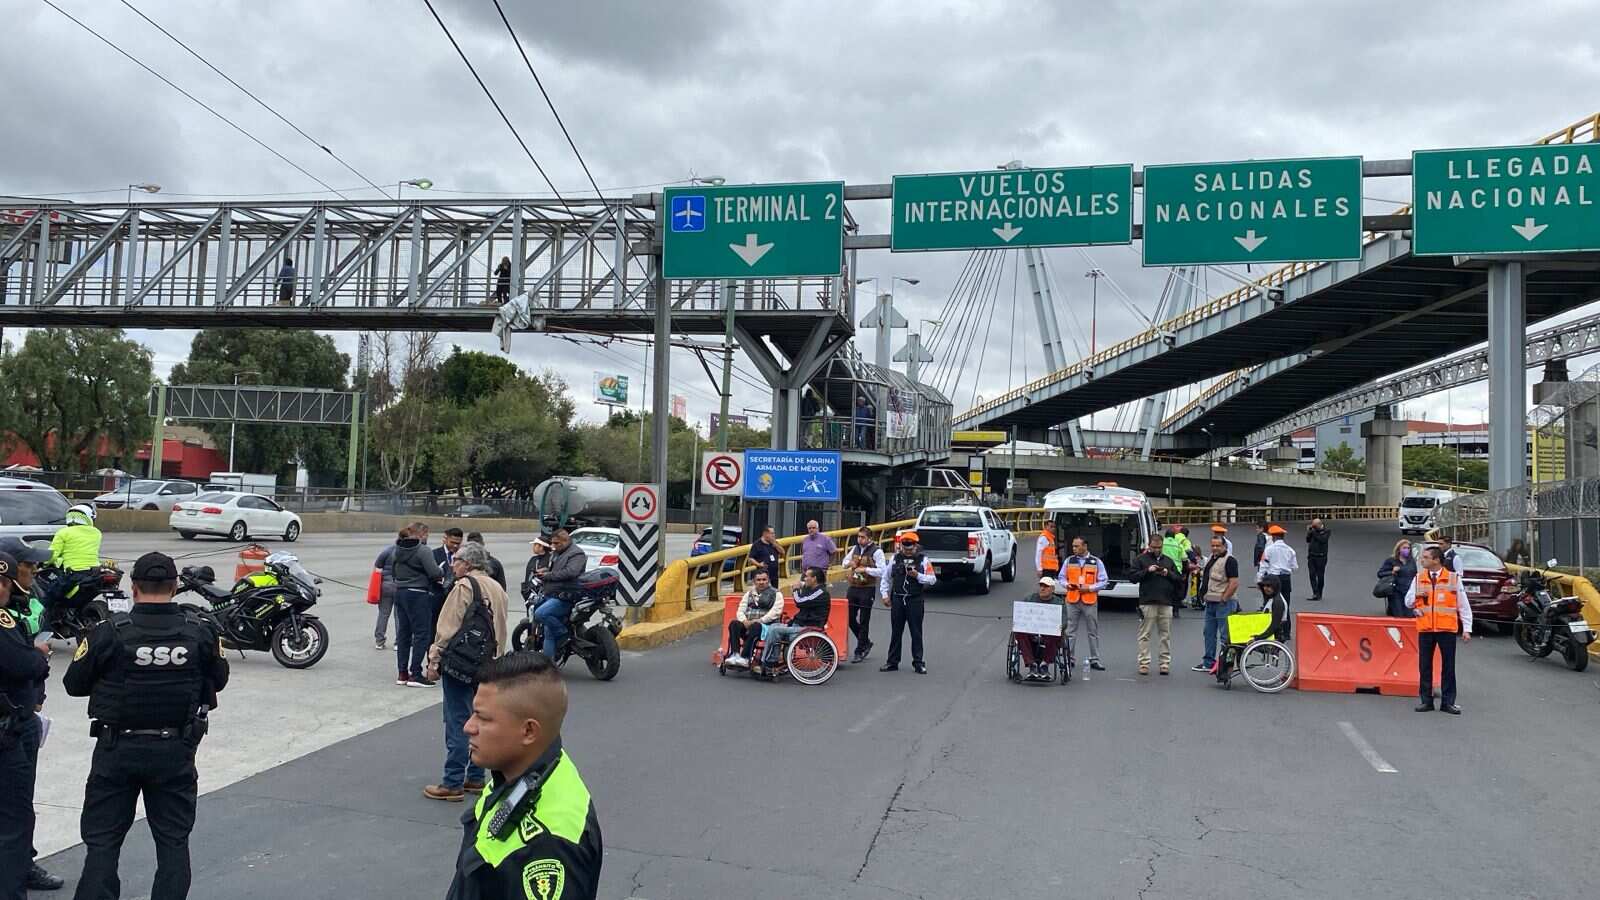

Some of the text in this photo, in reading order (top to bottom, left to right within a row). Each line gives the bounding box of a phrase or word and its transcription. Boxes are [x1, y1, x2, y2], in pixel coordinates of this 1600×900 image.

[1448, 154, 1593, 179] LLEGADA
[960, 172, 1066, 198] VUELOS
[1194, 168, 1312, 193] SALIDAS
[714, 193, 836, 224] TERMINAL 2
[905, 193, 1120, 224] INTERNACIONALES
[1157, 197, 1350, 223] NACIONALES
[1427, 185, 1593, 210] NACIONAL
[750, 455, 793, 464] SECRETARÍA
[807, 457, 835, 465] MARINA
[801, 464, 829, 473] MÉXICO
[135, 646, 188, 666] SSC
[1359, 638, 1373, 662] S
